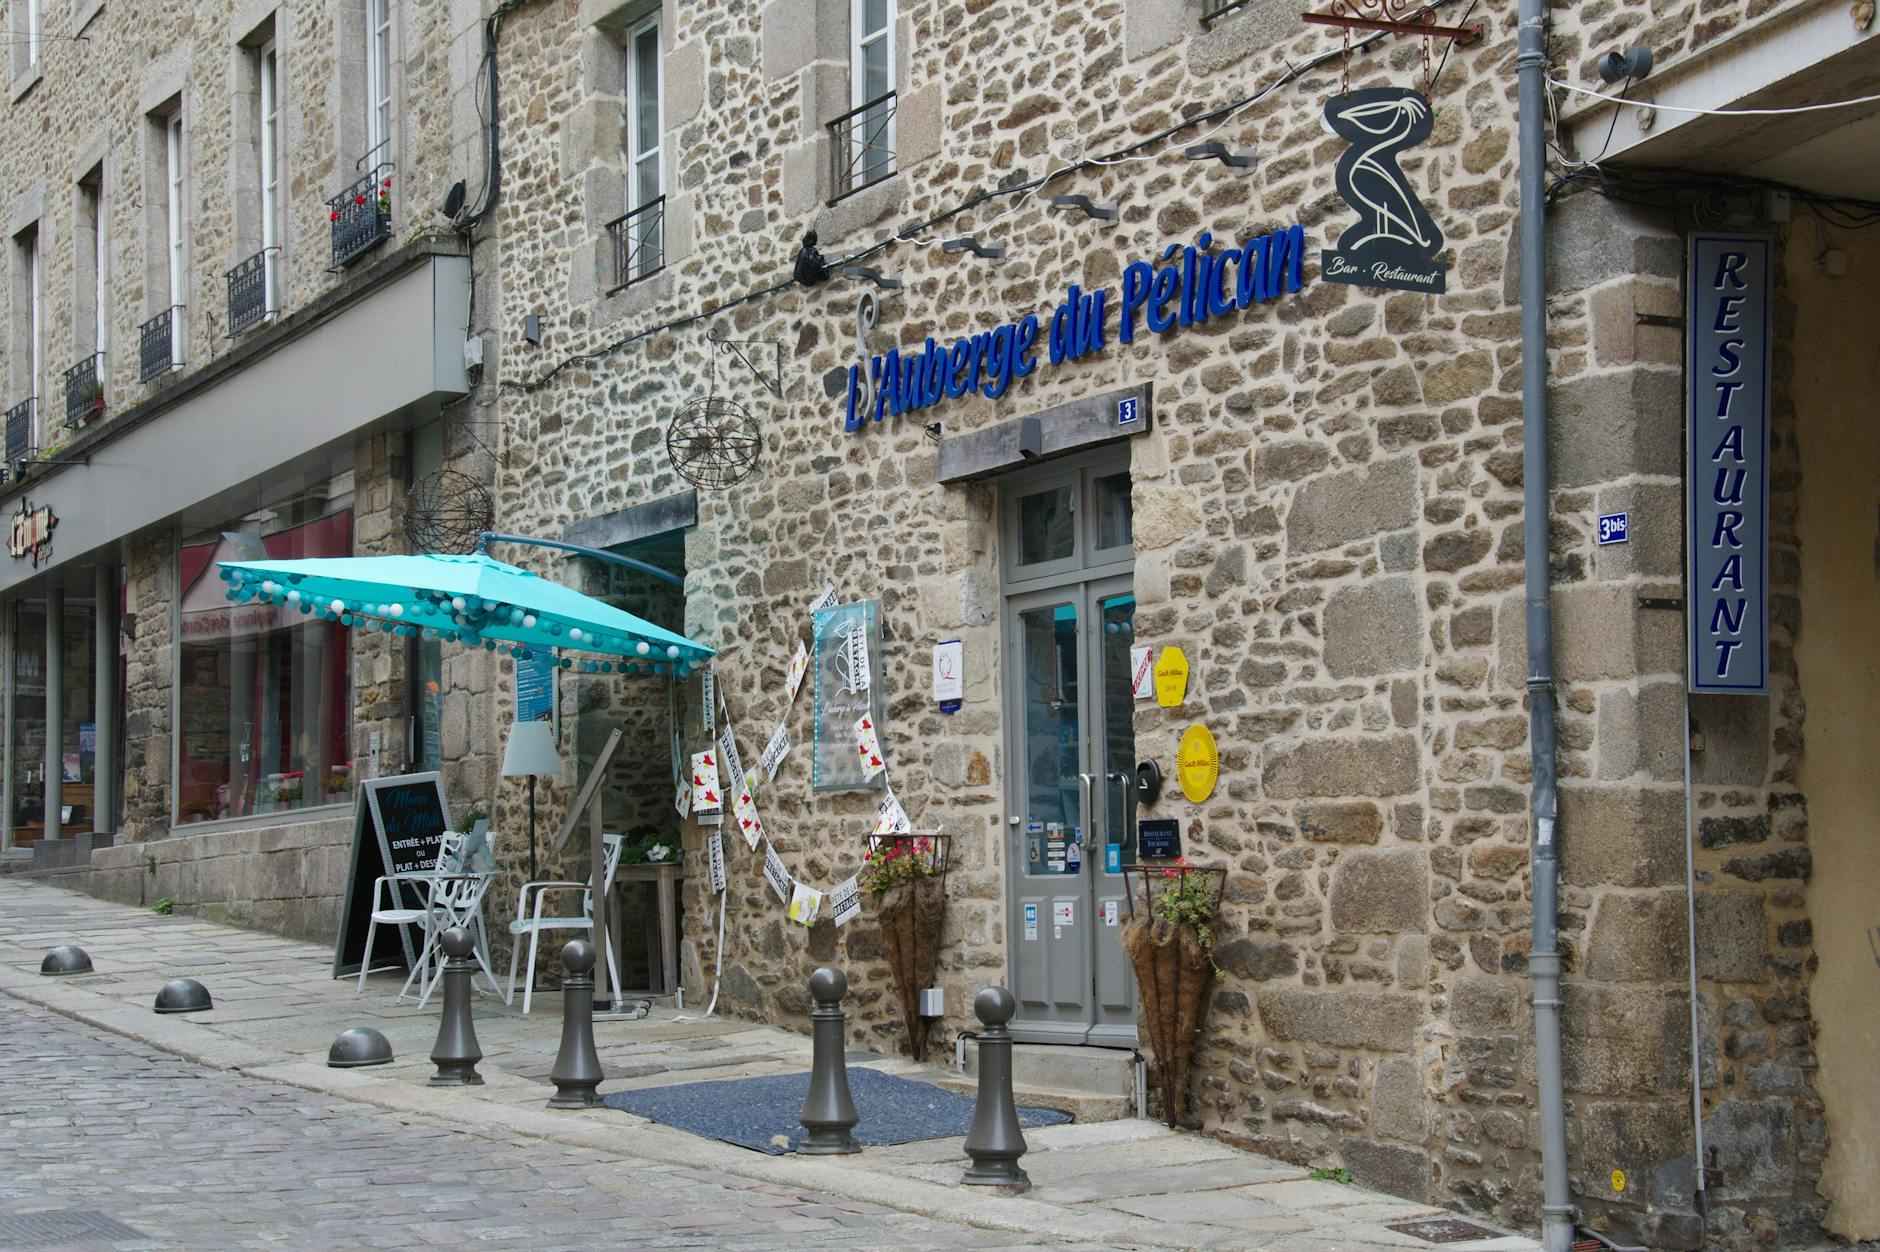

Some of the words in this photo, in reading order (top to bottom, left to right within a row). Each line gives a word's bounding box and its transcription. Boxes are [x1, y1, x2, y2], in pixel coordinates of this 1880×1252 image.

[1326, 256, 1358, 275] Bar
[1371, 261, 1440, 284] Restaurant
[845, 313, 1039, 432] L'Auberge
[1048, 284, 1106, 366] du
[1119, 224, 1305, 344] Pélican
[1124, 402, 1132, 419] 3
[1711, 252, 1748, 679] RESTAURANT
[1601, 517, 1626, 540] 3bis
[392, 837, 420, 849] ENTRÉE
[396, 863, 413, 872] PLAT
